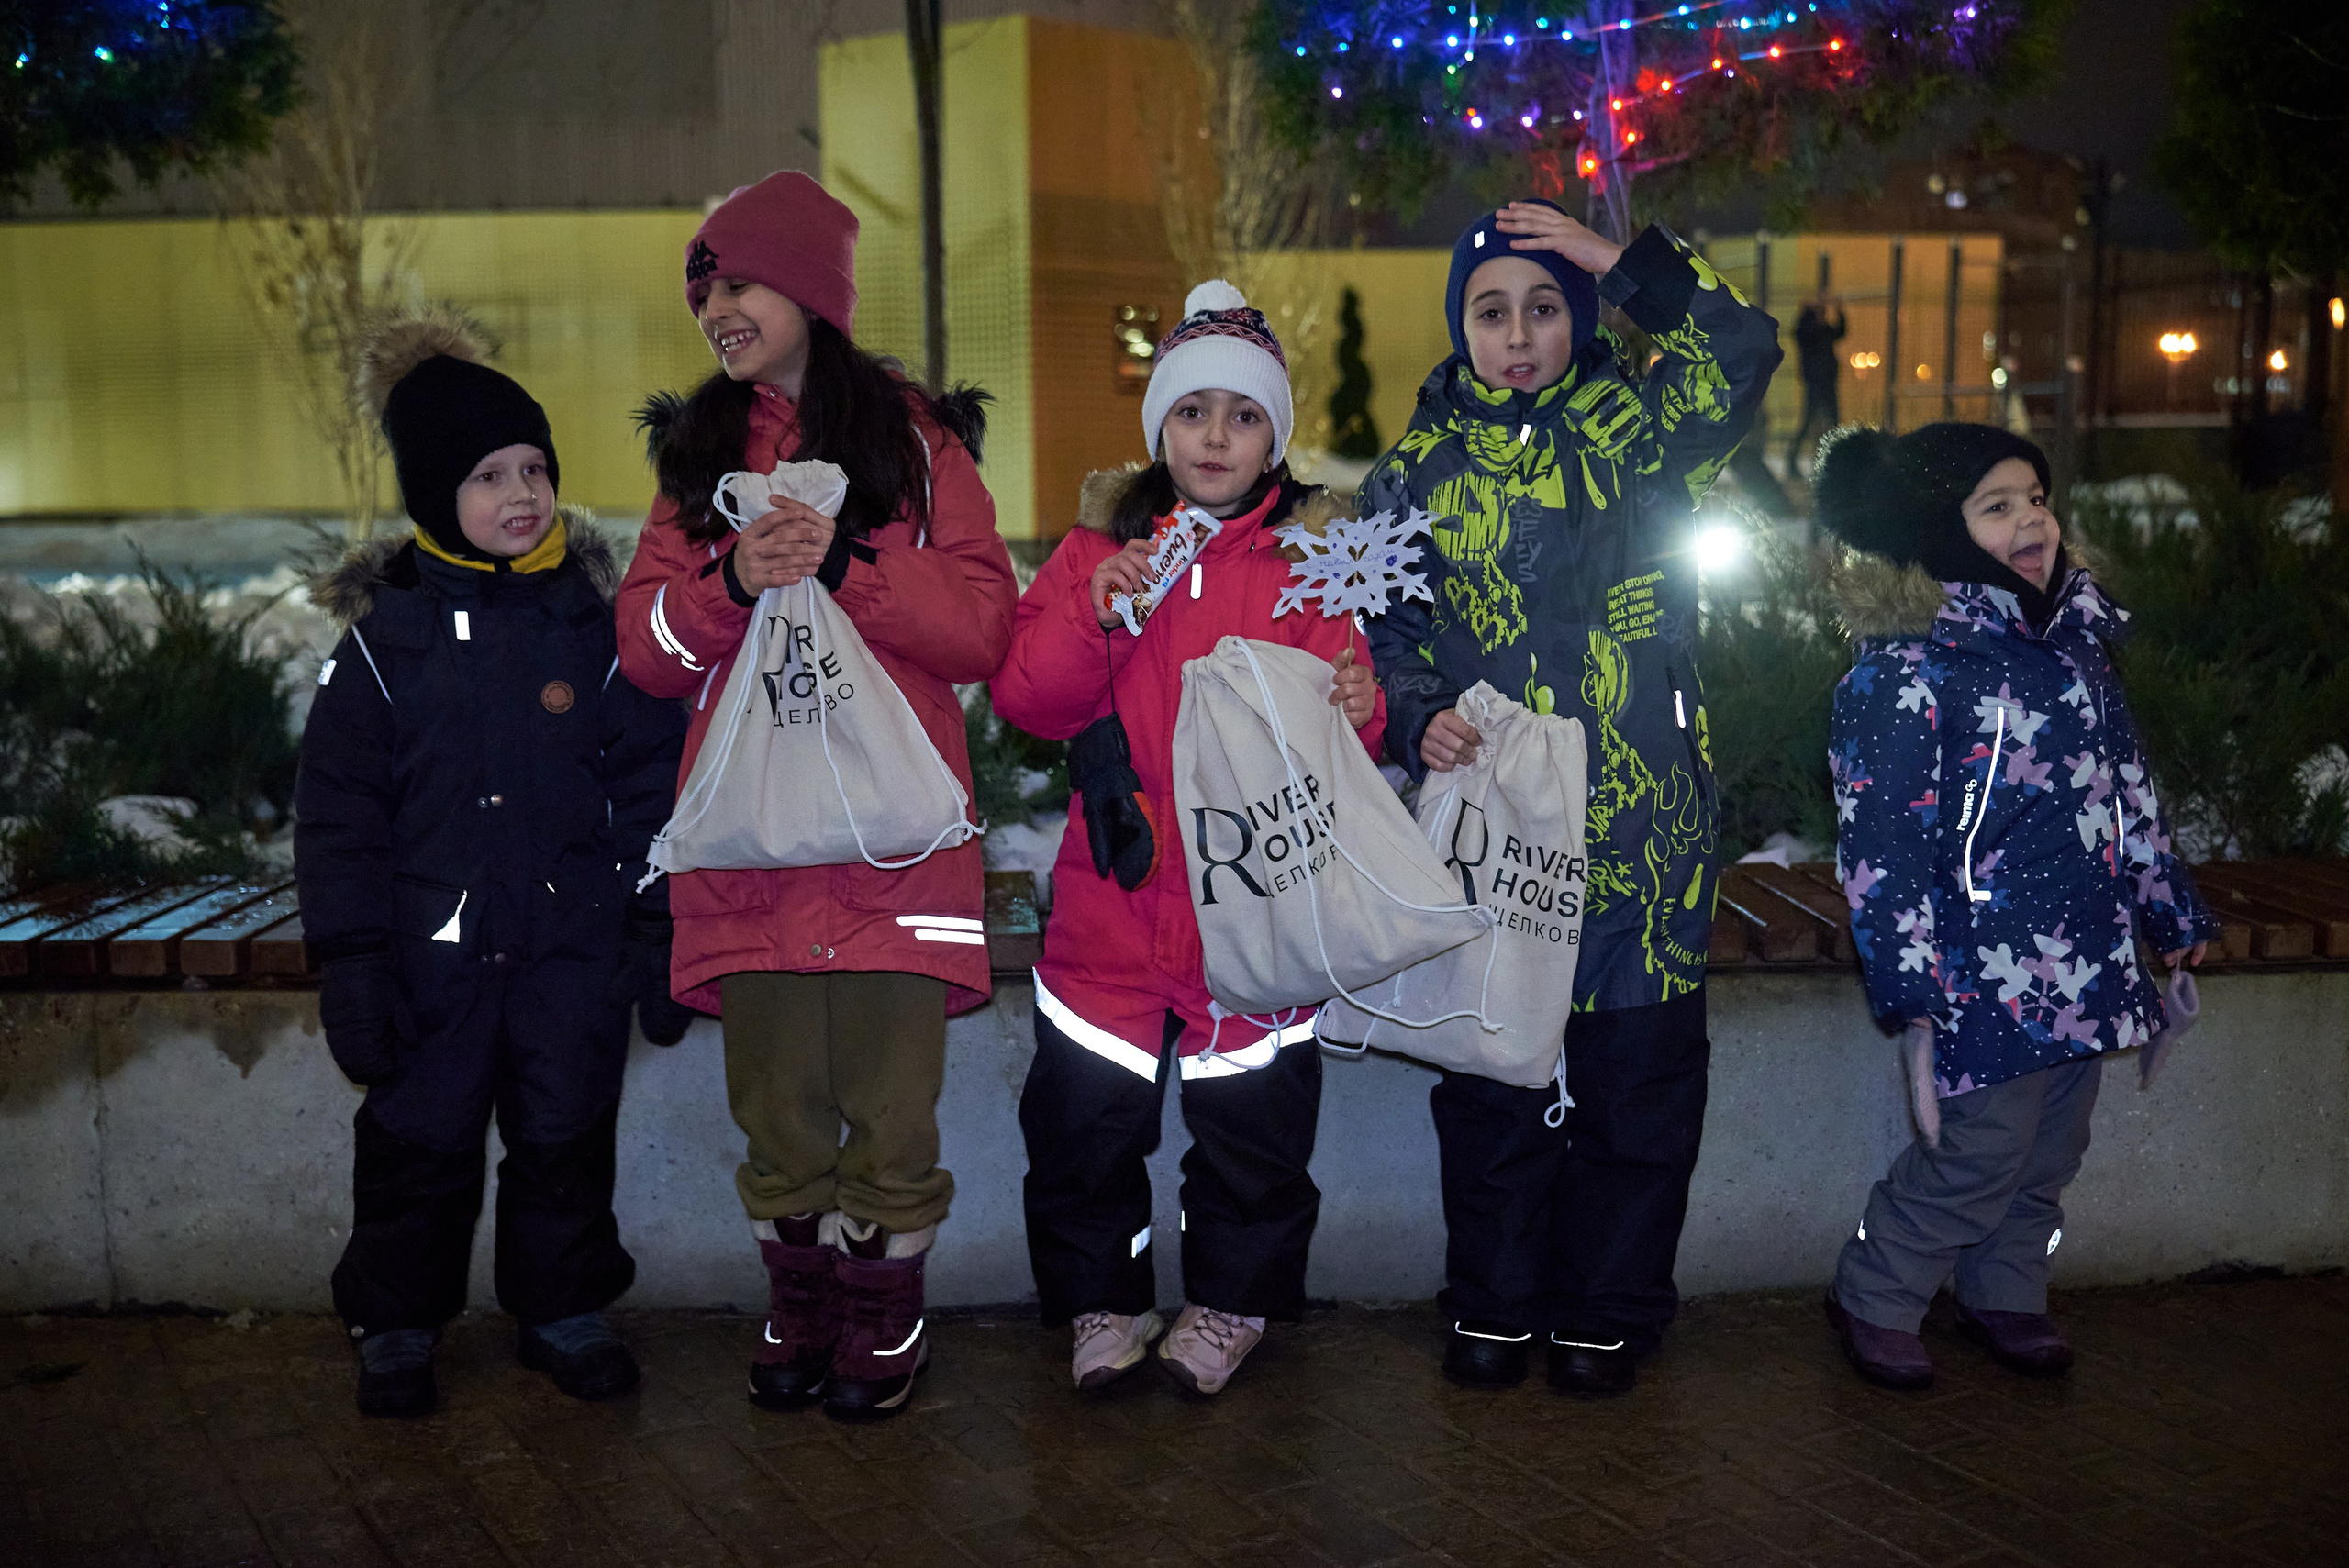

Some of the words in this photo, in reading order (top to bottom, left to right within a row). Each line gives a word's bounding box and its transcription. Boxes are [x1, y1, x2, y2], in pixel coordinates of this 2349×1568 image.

[1152, 532, 1188, 584] bueno
[1608, 607, 1627, 624] STILL
[1502, 834, 1586, 883] RIVER
[1491, 867, 1579, 918] HOUS
